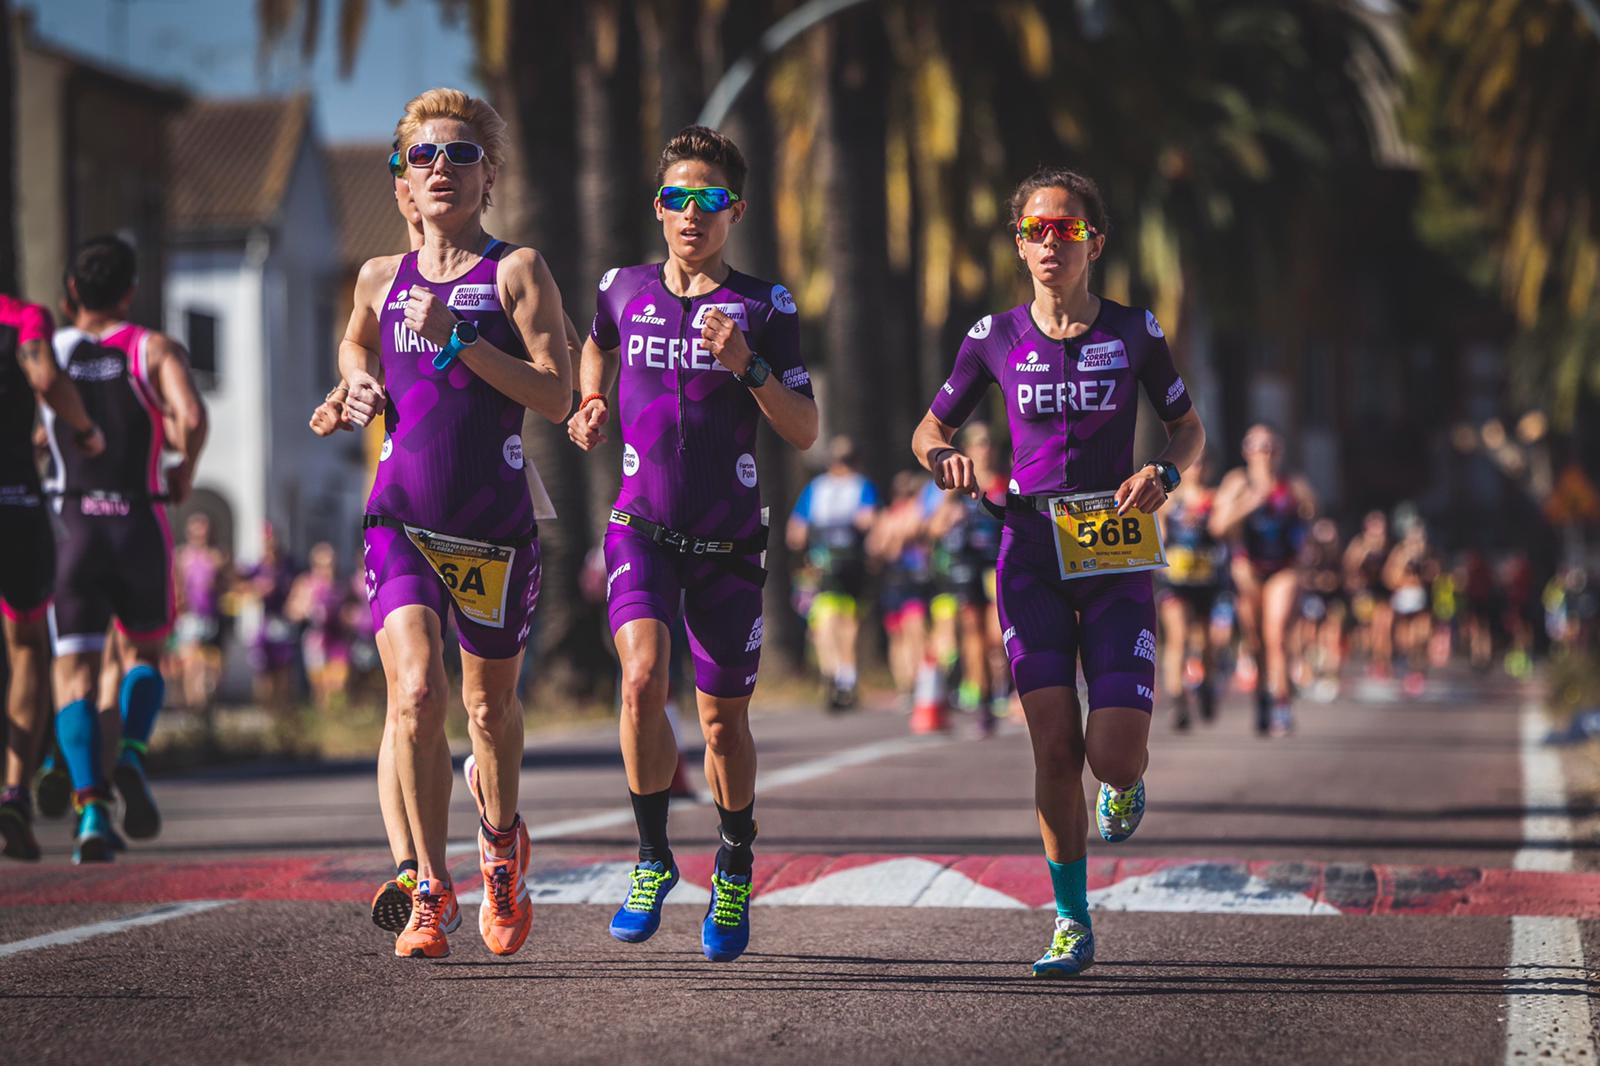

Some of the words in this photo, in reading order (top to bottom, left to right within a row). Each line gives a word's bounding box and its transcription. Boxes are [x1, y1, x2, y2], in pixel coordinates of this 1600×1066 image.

[631, 314, 666, 326] VIATOR
[1016, 362, 1050, 372] VIATOR
[1017, 379, 1118, 415] PEREZ
[1077, 517, 1142, 548] 56B
